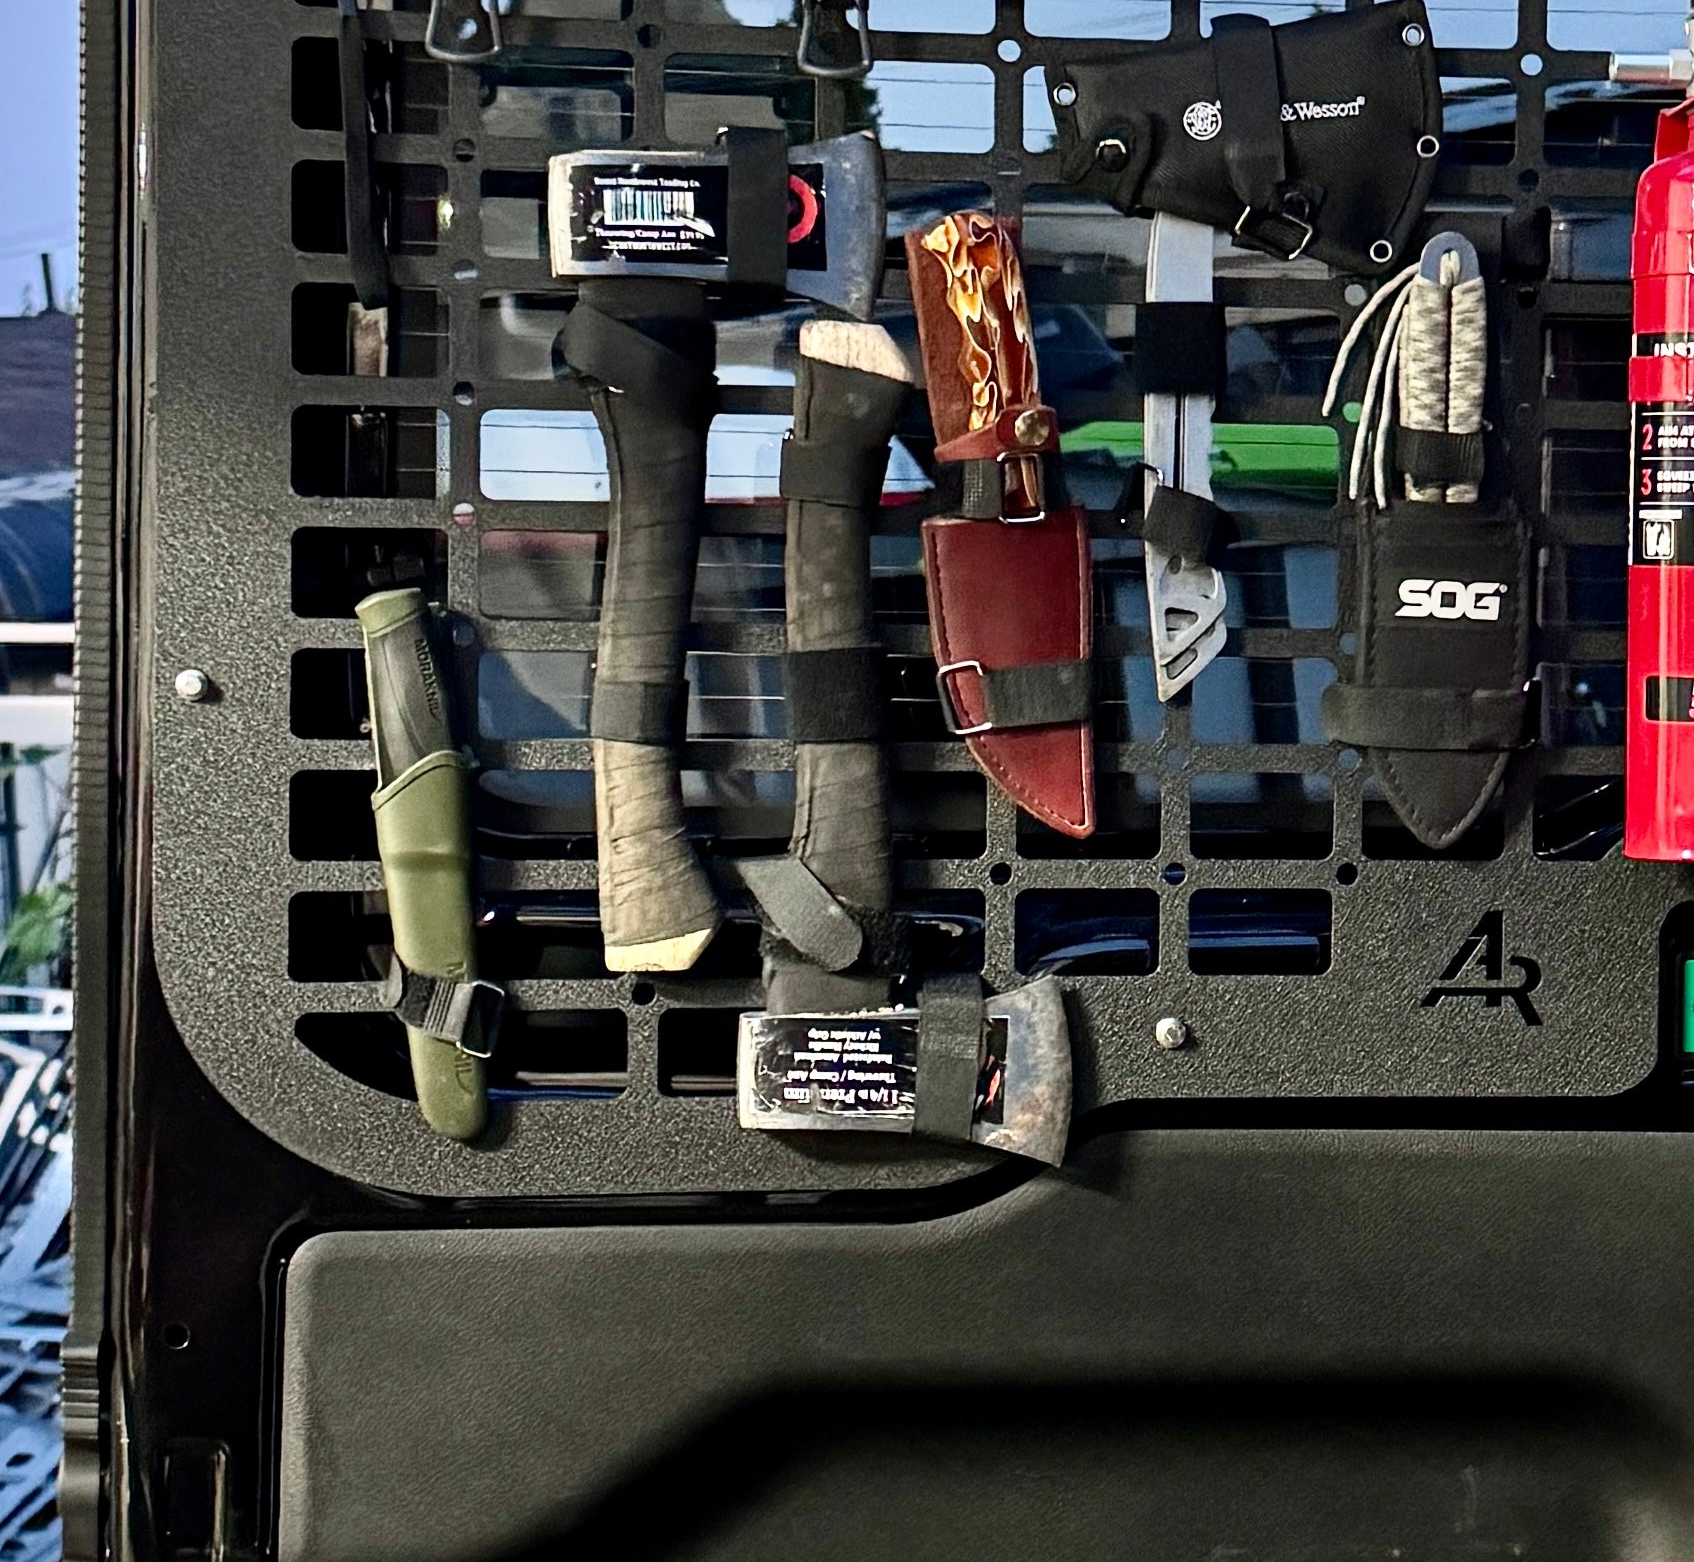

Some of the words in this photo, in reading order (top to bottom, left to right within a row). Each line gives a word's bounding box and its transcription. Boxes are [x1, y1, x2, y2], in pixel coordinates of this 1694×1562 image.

[1642, 423, 1653, 451] 2
[1657, 437, 1689, 448] FROM
[1640, 468, 1652, 496] 3
[1395, 579, 1502, 621] SOG
